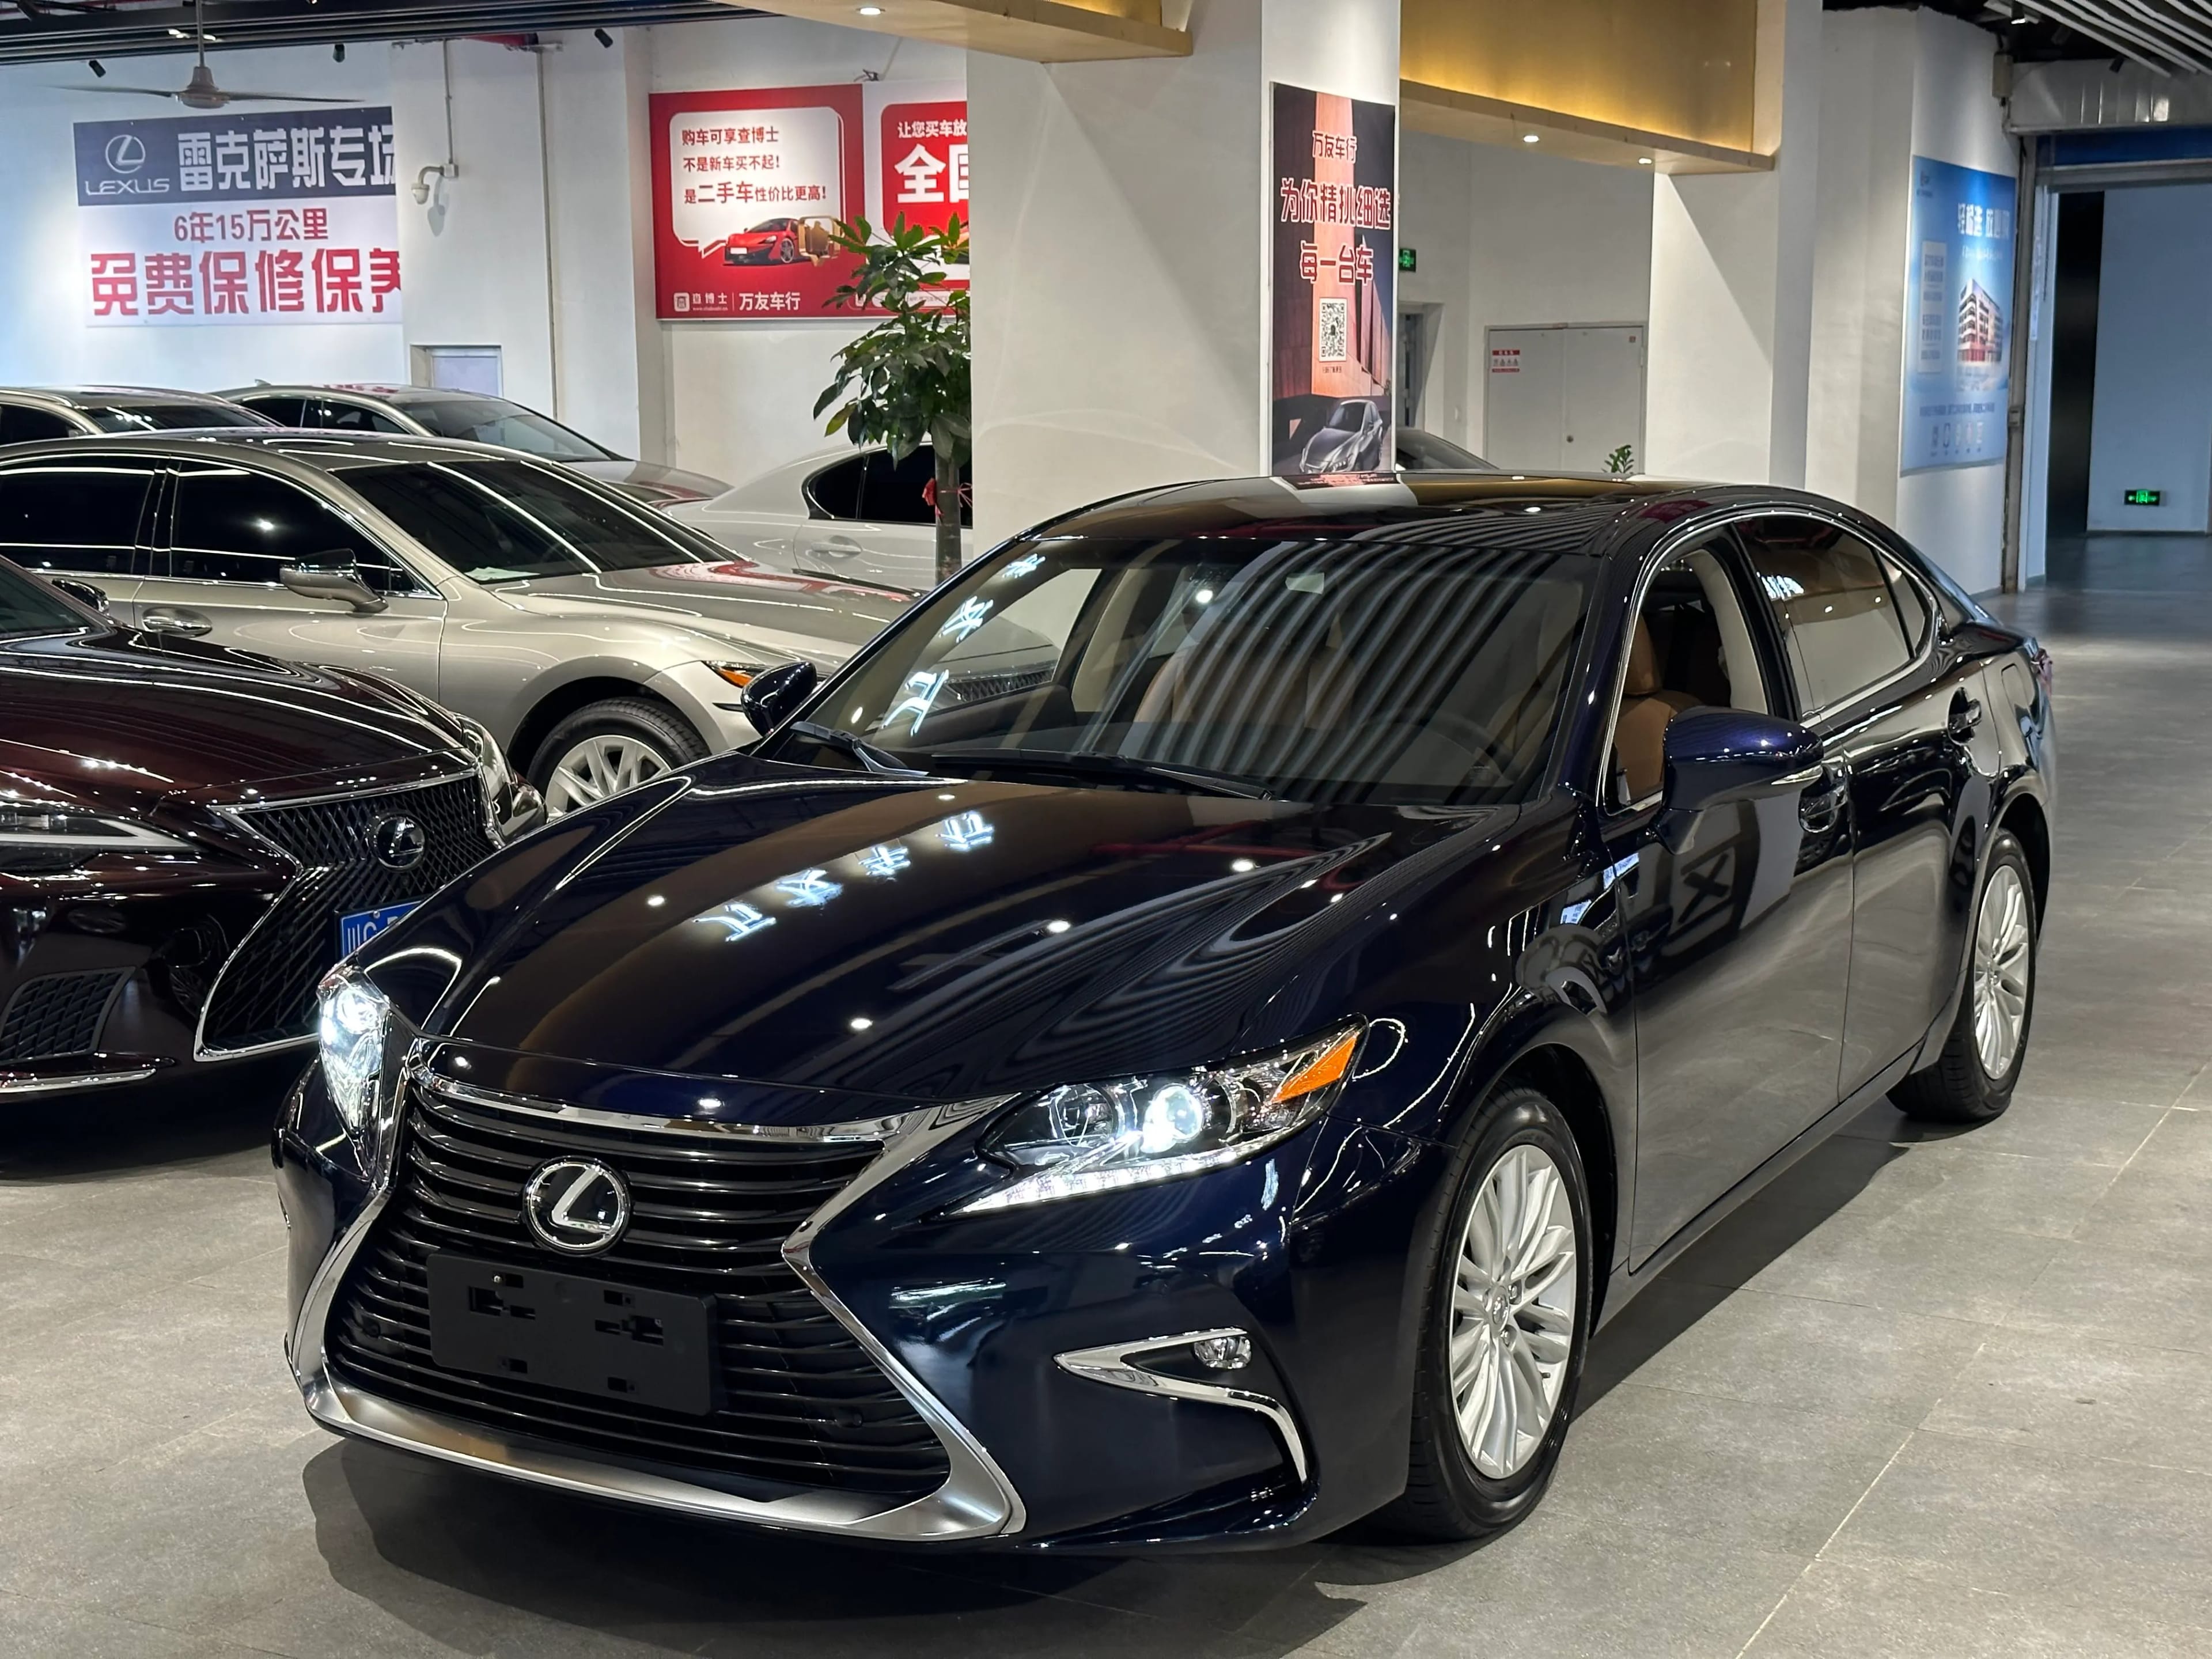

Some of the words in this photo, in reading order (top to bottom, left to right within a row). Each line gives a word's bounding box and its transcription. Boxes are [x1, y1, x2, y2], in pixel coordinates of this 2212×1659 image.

[681, 126, 779, 146] 购车可享查博士
[897, 119, 967, 139] 让您买车放
[1312, 130, 1357, 164] 万友车行
[683, 154, 780, 172] 不是新车买不起！
[85, 178, 169, 196] LEXUS
[684, 181, 827, 204] 是二手车性价比更高！
[1281, 177, 1391, 230] 为你精挑细选
[174, 207, 328, 244] 6年15万公里
[1300, 240, 1373, 285] 每一台车
[739, 291, 801, 310] 万友车行
